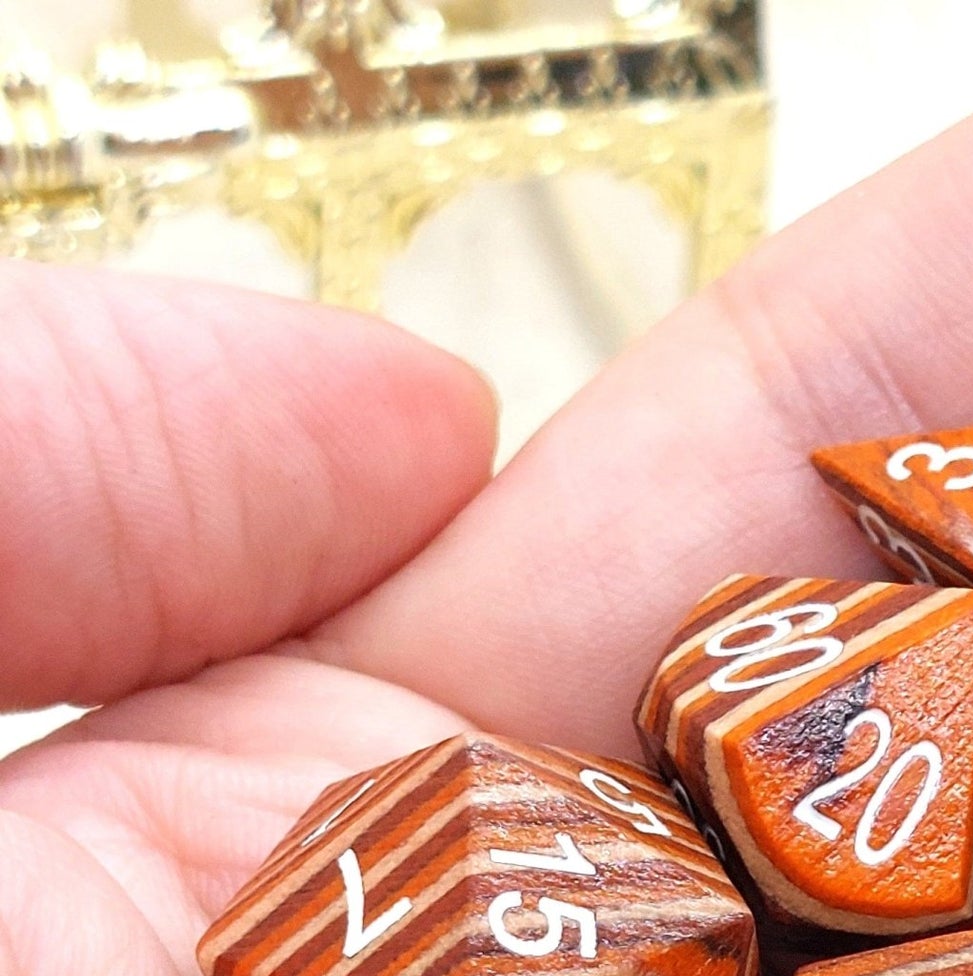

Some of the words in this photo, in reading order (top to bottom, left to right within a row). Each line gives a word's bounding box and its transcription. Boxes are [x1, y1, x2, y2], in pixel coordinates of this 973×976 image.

[705, 602, 844, 693] 60
[579, 768, 672, 837] 5
[793, 708, 942, 866] 20
[338, 849, 414, 959] 7
[488, 833, 598, 959] 15
